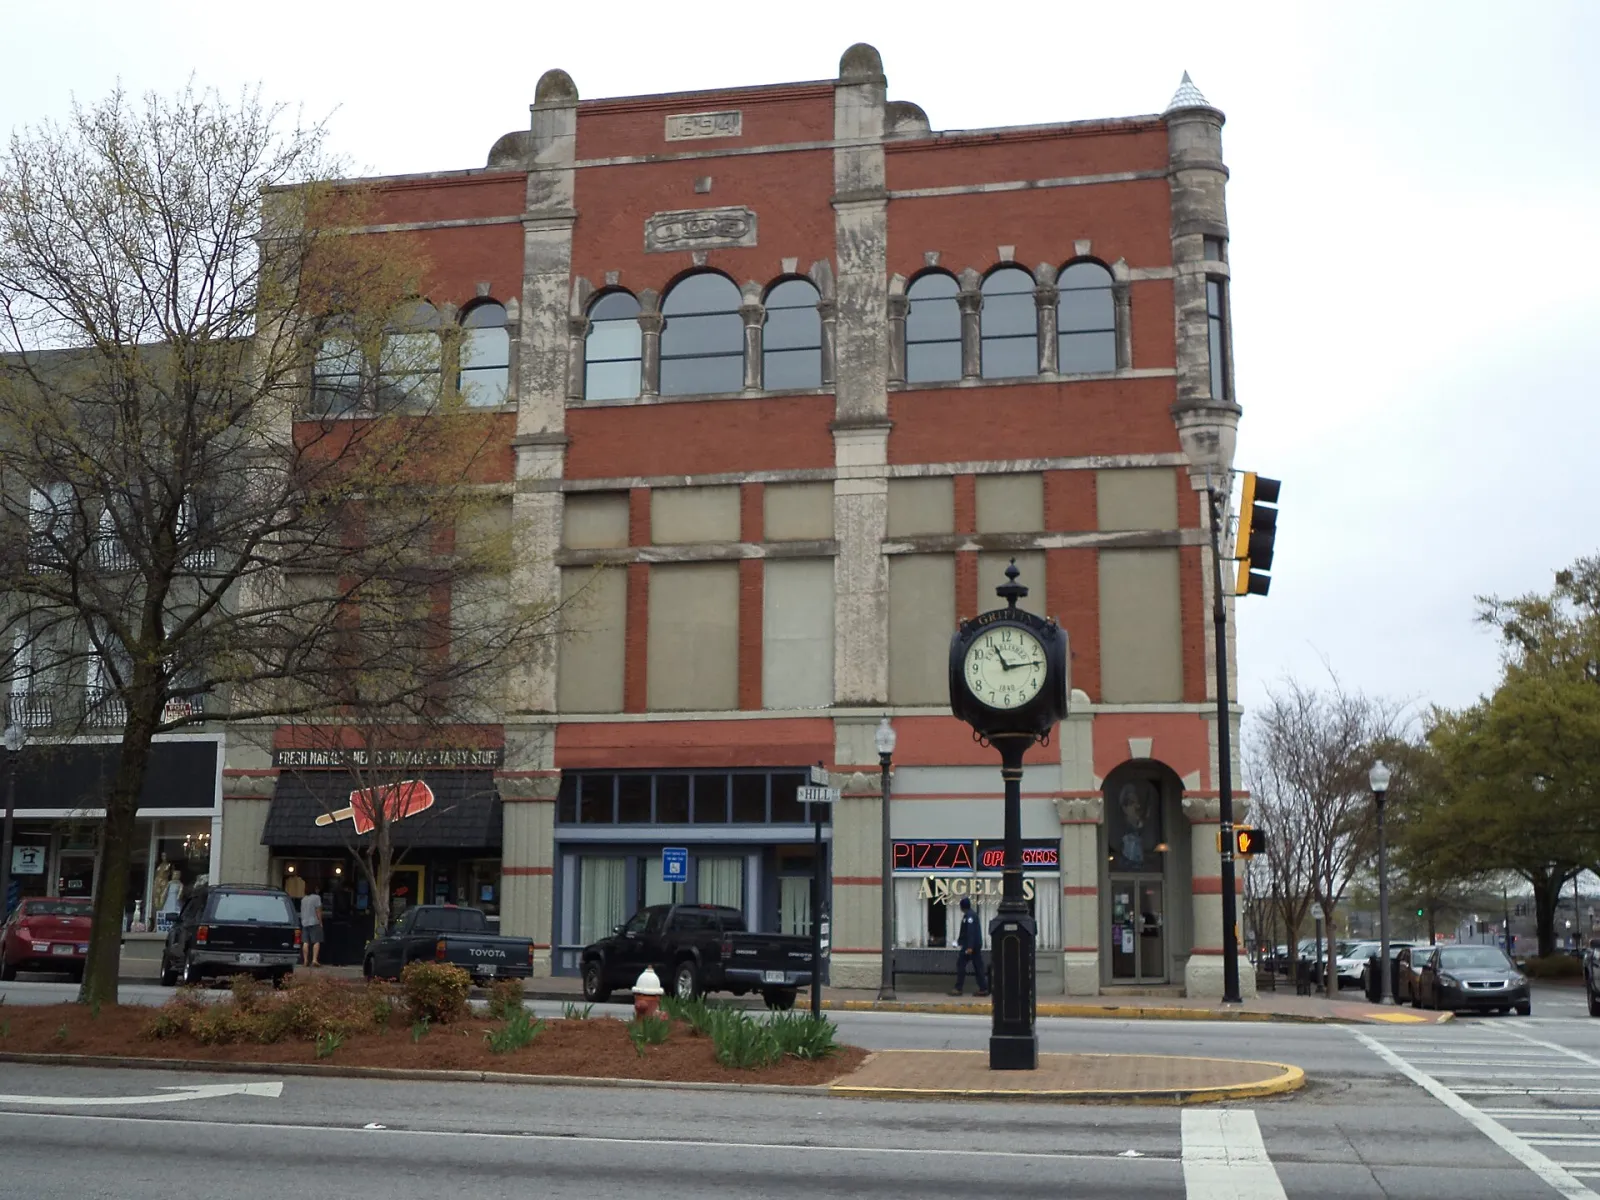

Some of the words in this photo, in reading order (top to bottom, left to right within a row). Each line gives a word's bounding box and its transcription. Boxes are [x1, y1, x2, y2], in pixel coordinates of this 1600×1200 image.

[672, 114, 736, 137] 1894
[986, 635, 993, 648] 11
[1002, 631, 1012, 642] 12
[1020, 634, 1024, 646] 1
[974, 649, 984, 661] 10
[985, 643, 1027, 660] ESTBLISHED
[1032, 645, 1039, 656] 2
[972, 664, 979, 675] 9
[975, 680, 982, 692] 8
[1030, 678, 1037, 690] 4
[988, 691, 995, 703] 7
[1004, 694, 1010, 706] 6
[1019, 690, 1026, 702] 5
[278, 751, 307, 764] FRESH
[353, 751, 383, 764] MEAS
[805, 789, 831, 800] HILL
[893, 843, 972, 869] PIZZA
[983, 850, 1005, 867] OP
[1022, 849, 1058, 863] GYROS
[918, 876, 1035, 900] ANGELS
[469, 948, 506, 958] TOYOTA
